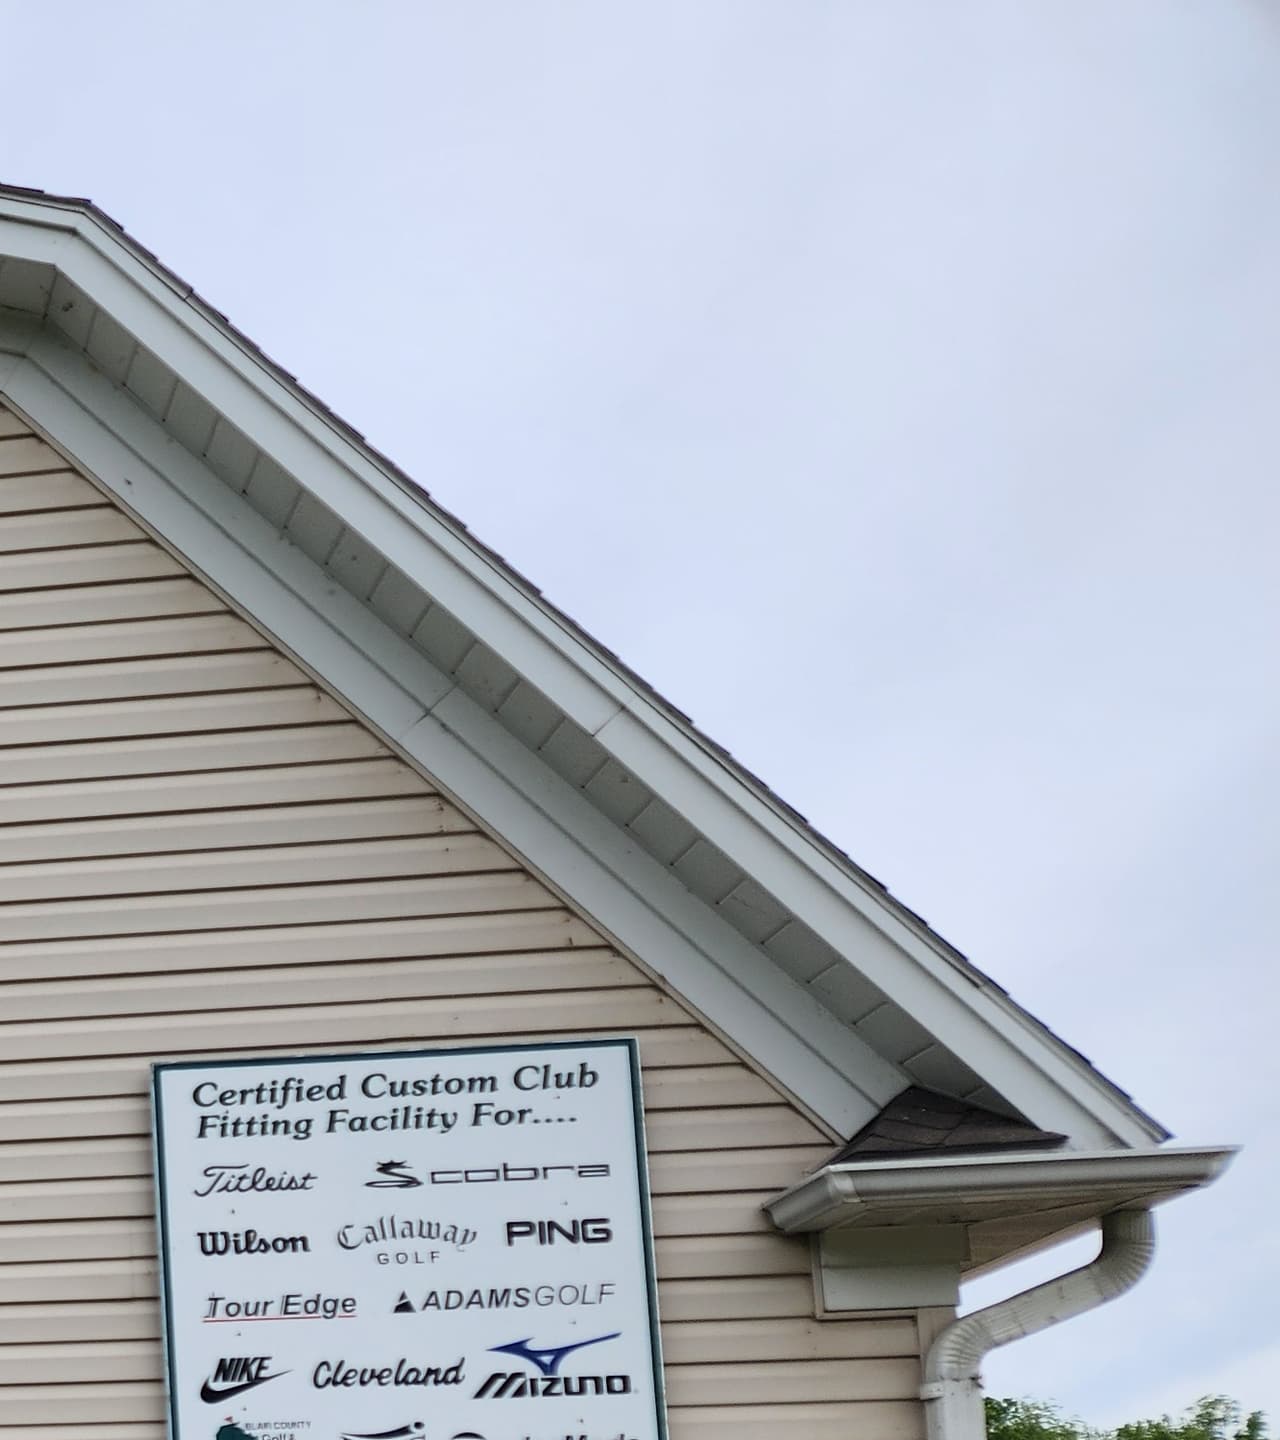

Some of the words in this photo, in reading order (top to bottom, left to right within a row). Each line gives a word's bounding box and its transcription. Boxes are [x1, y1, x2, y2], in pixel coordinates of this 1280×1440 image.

[192, 1075, 347, 1109] Certified
[361, 1070, 499, 1099] Custom
[513, 1062, 600, 1091] Club
[196, 1107, 314, 1141] Fitting
[326, 1102, 458, 1134] Facility
[194, 1162, 320, 1198] Titleist
[196, 1227, 312, 1257] Wilson
[336, 1214, 479, 1253] Callaway
[505, 1216, 613, 1248] PING
[376, 1250, 442, 1266] GOLF
[203, 1295, 274, 1319] Tour
[280, 1292, 358, 1321] Edge
[421, 1282, 617, 1312] ADAMSGOLF
[213, 1355, 274, 1384] NIKE
[313, 1356, 467, 1389] Cleveland
